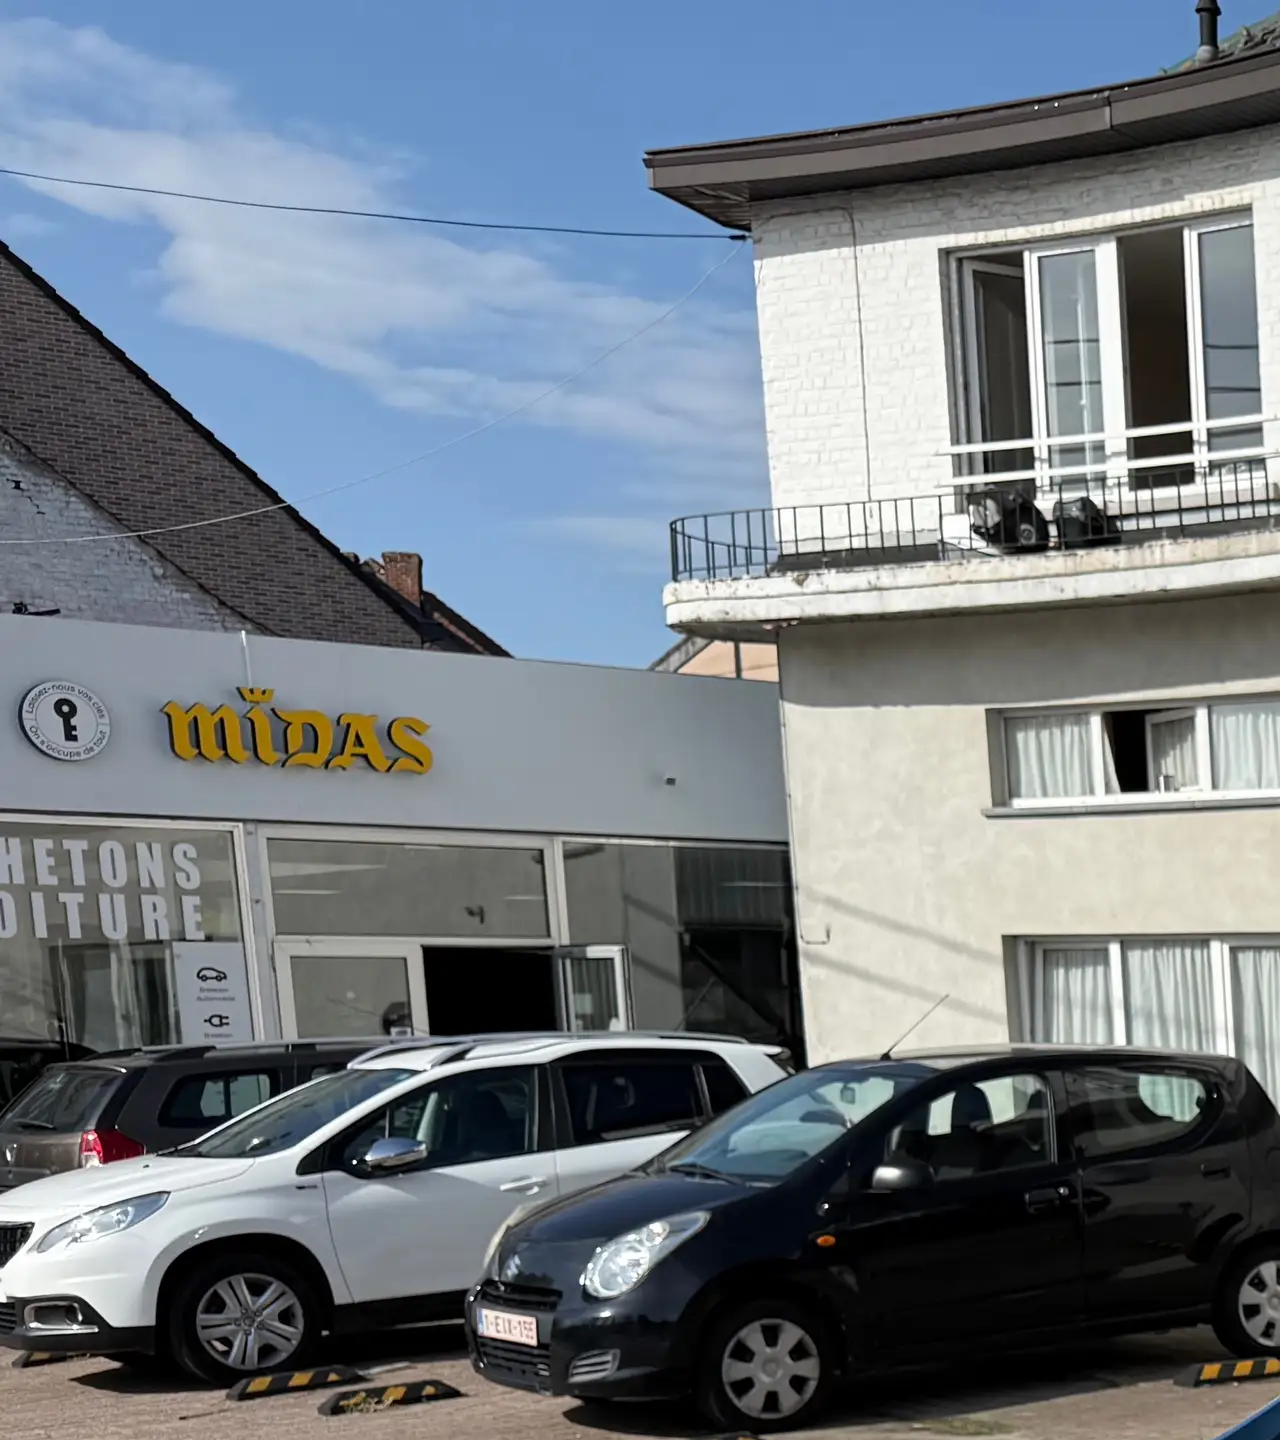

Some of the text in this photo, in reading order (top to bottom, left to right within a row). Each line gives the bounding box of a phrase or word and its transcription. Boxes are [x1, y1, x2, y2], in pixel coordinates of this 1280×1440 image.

[77, 688, 93, 702] vos
[29, 725, 40, 740] On
[83, 746, 95, 756] de
[93, 730, 107, 748] tout
